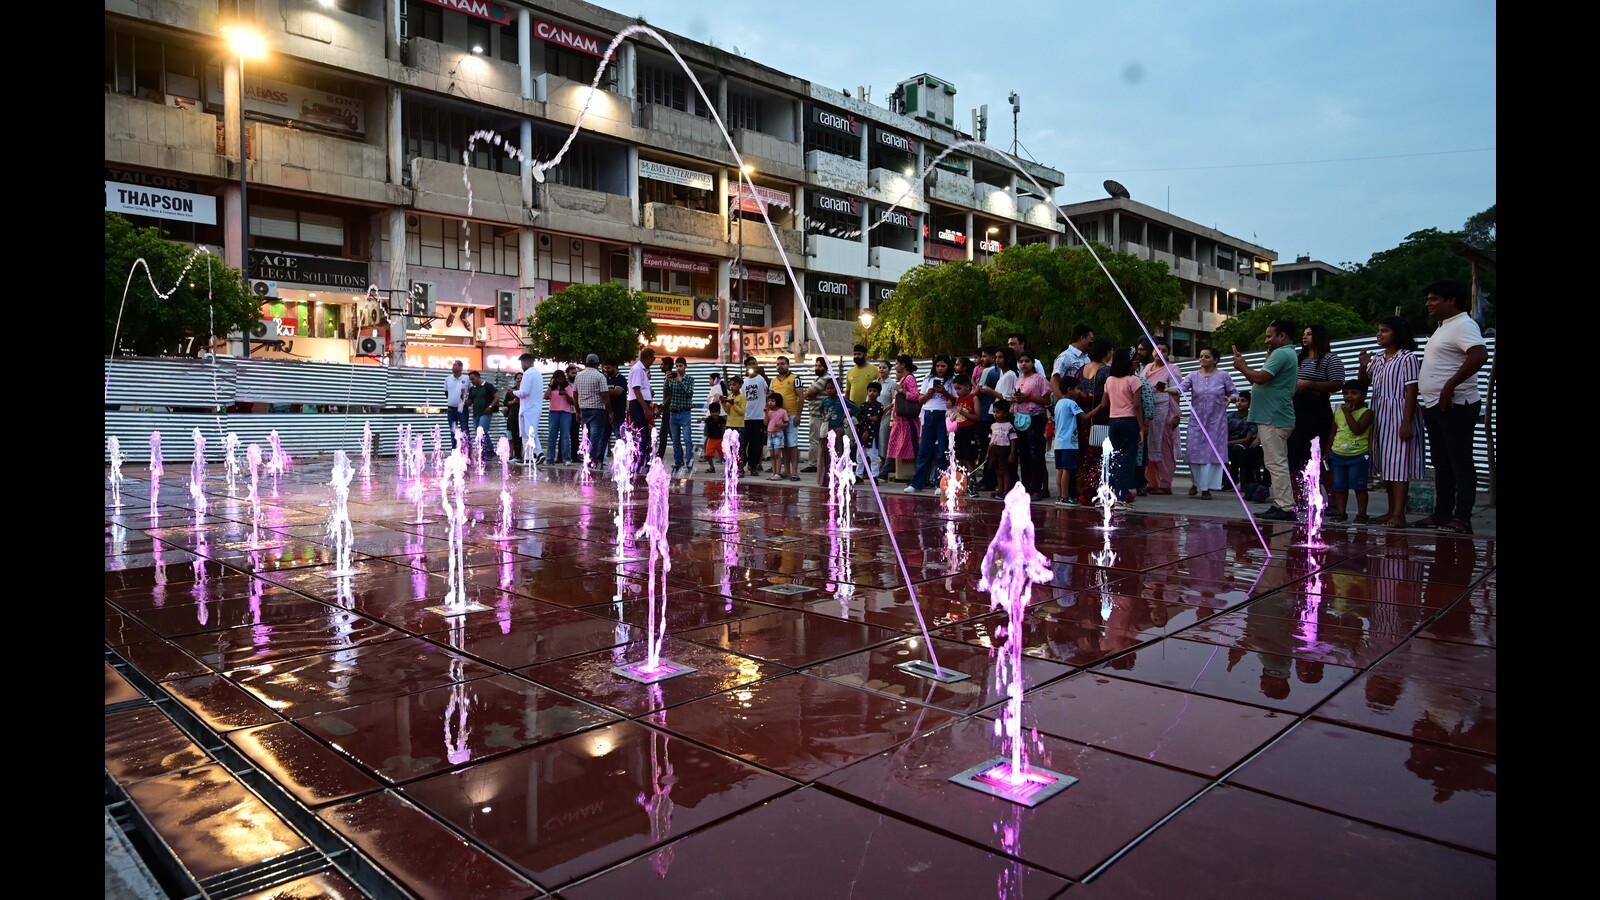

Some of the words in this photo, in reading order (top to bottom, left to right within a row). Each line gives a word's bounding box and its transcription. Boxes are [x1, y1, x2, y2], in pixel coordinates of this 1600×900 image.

[537, 23, 598, 54] CANAM
[819, 111, 850, 132] canam
[881, 132, 909, 150] canam
[108, 170, 190, 191] TAILORS
[667, 167, 711, 183] ENTERPRISES
[117, 189, 193, 212] THAPSON
[819, 196, 851, 213] canam
[881, 210, 908, 227] canam
[260, 255, 298, 268] ACE
[643, 257, 662, 266] Expert
[670, 261, 692, 269] Refused
[693, 264, 709, 272] Cases
[260, 268, 300, 281] LEGAL
[303, 272, 366, 287] SOLUTIONS
[818, 280, 848, 295] canam
